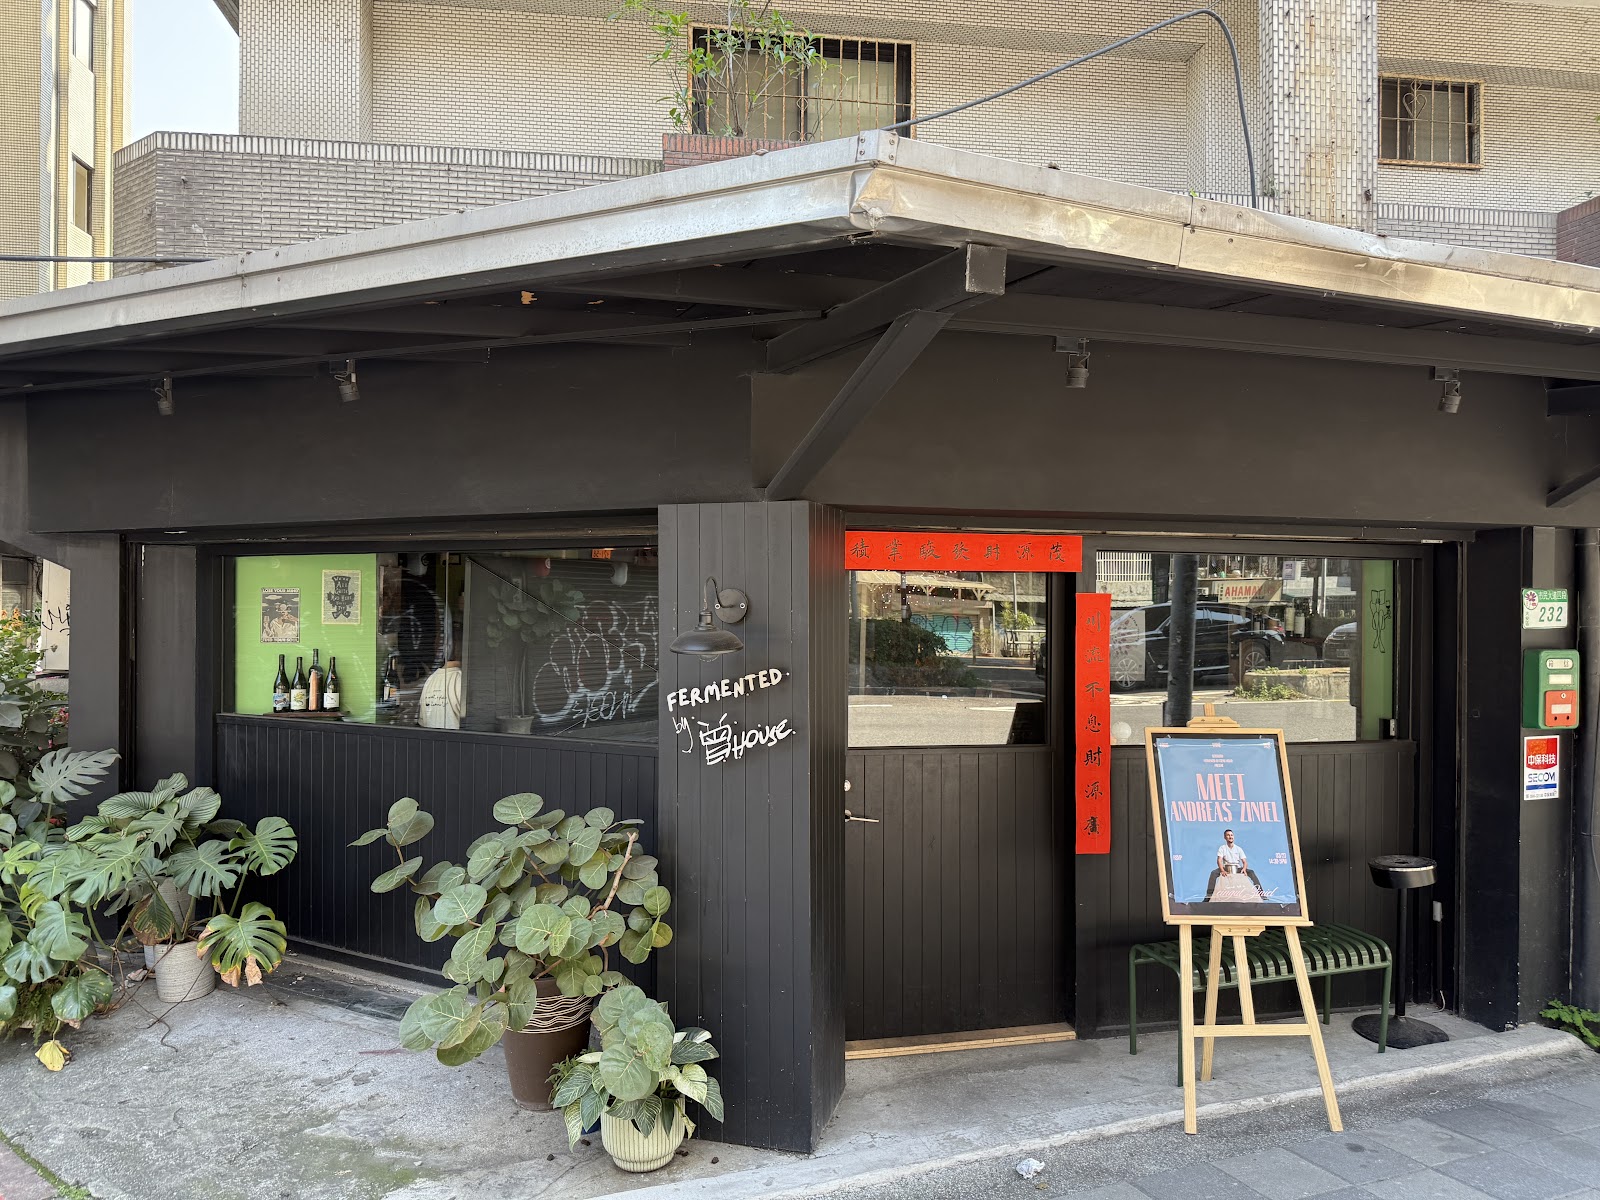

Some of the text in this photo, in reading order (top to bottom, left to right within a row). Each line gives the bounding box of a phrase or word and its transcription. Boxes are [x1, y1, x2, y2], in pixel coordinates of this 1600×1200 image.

[1539, 606, 1563, 622] 232
[666, 668, 782, 712] FERMENTED
[672, 716, 694, 753] by
[1527, 754, 1556, 766] 中保科技
[1196, 774, 1245, 800] MEET
[1528, 772, 1556, 783] SECOM
[1170, 801, 1281, 823] ANDREAS ZINIEL
